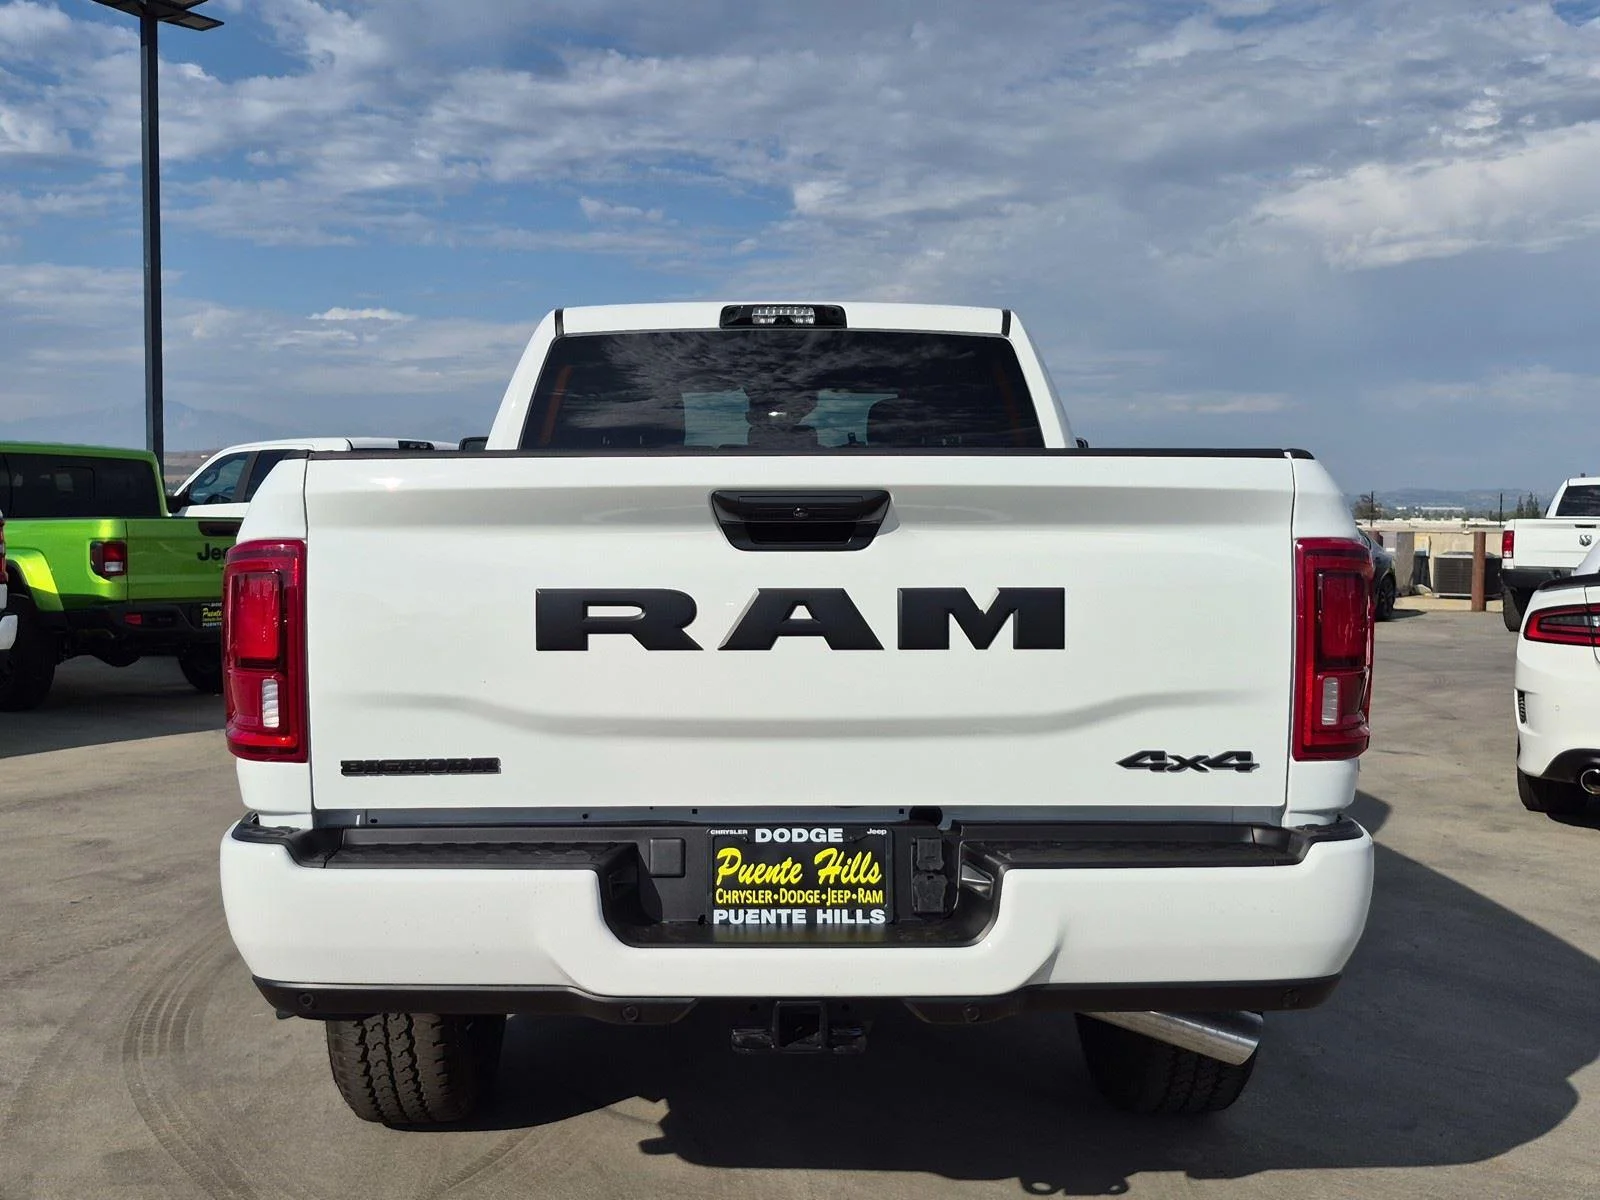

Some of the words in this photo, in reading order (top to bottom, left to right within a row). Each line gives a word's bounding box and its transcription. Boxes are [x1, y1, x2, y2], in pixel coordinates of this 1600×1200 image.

[536, 587, 1065, 651] RAM
[1115, 750, 1260, 773] 4x4
[755, 828, 844, 843] DODGE
[867, 828, 887, 836] Jeep
[716, 847, 803, 886] Puente
[814, 847, 882, 885] Hills
[713, 909, 807, 925] PUENTE
[816, 909, 887, 925] HILLS
